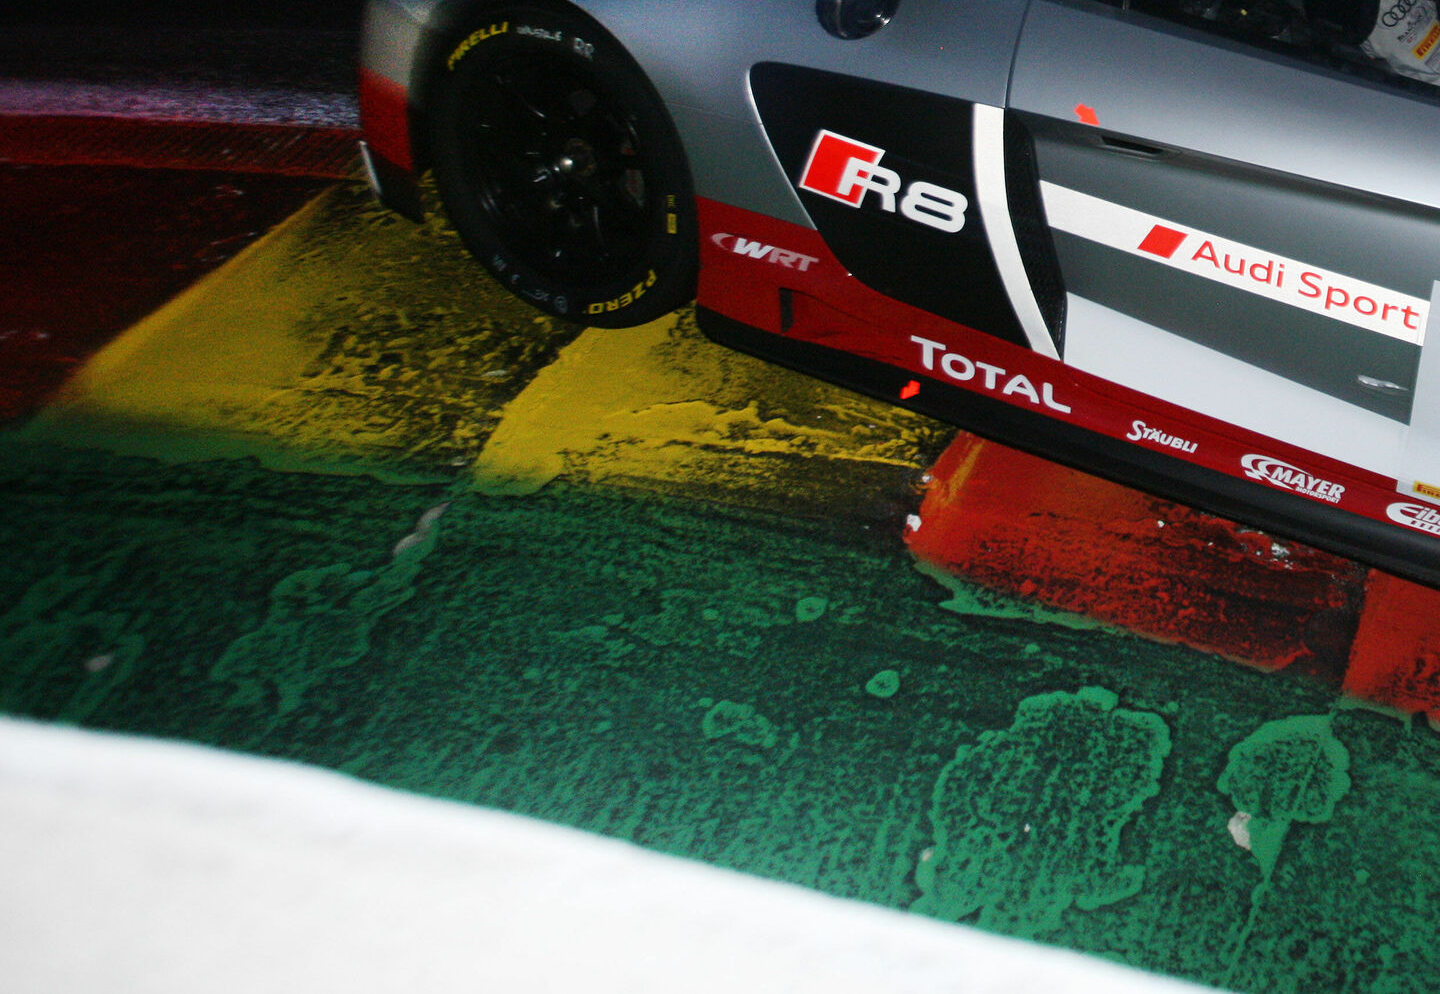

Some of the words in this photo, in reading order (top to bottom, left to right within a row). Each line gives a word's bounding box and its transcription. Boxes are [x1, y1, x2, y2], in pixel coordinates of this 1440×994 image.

[834, 149, 968, 234] R8
[730, 236, 819, 271] WRT
[1191, 240, 1285, 287] Audi
[1298, 271, 1421, 331] Sport
[909, 335, 1071, 414] TOTAL
[1126, 419, 1198, 454] STÄUBLI
[1271, 466, 1346, 499] MAYER
[1295, 486, 1341, 504] MOTORSPORT
